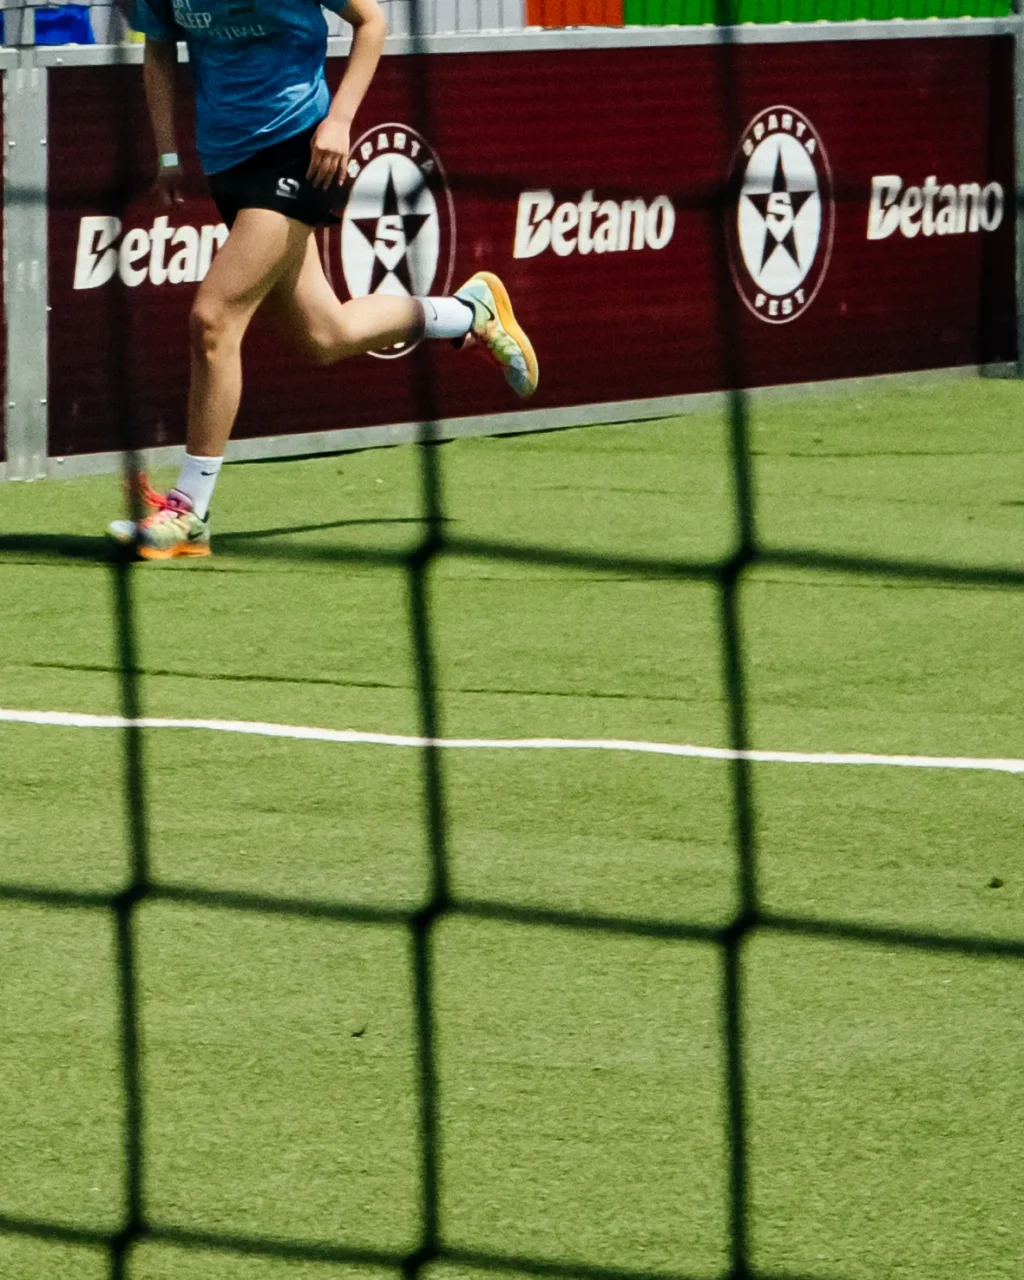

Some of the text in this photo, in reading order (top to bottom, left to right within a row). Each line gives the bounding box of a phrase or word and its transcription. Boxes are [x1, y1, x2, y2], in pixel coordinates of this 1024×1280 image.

[742, 114, 817, 157] SPARTA
[513, 188, 676, 259] Betano
[867, 174, 1005, 241] Betano
[73, 216, 230, 290] Betan
[755, 289, 805, 316] FEST
